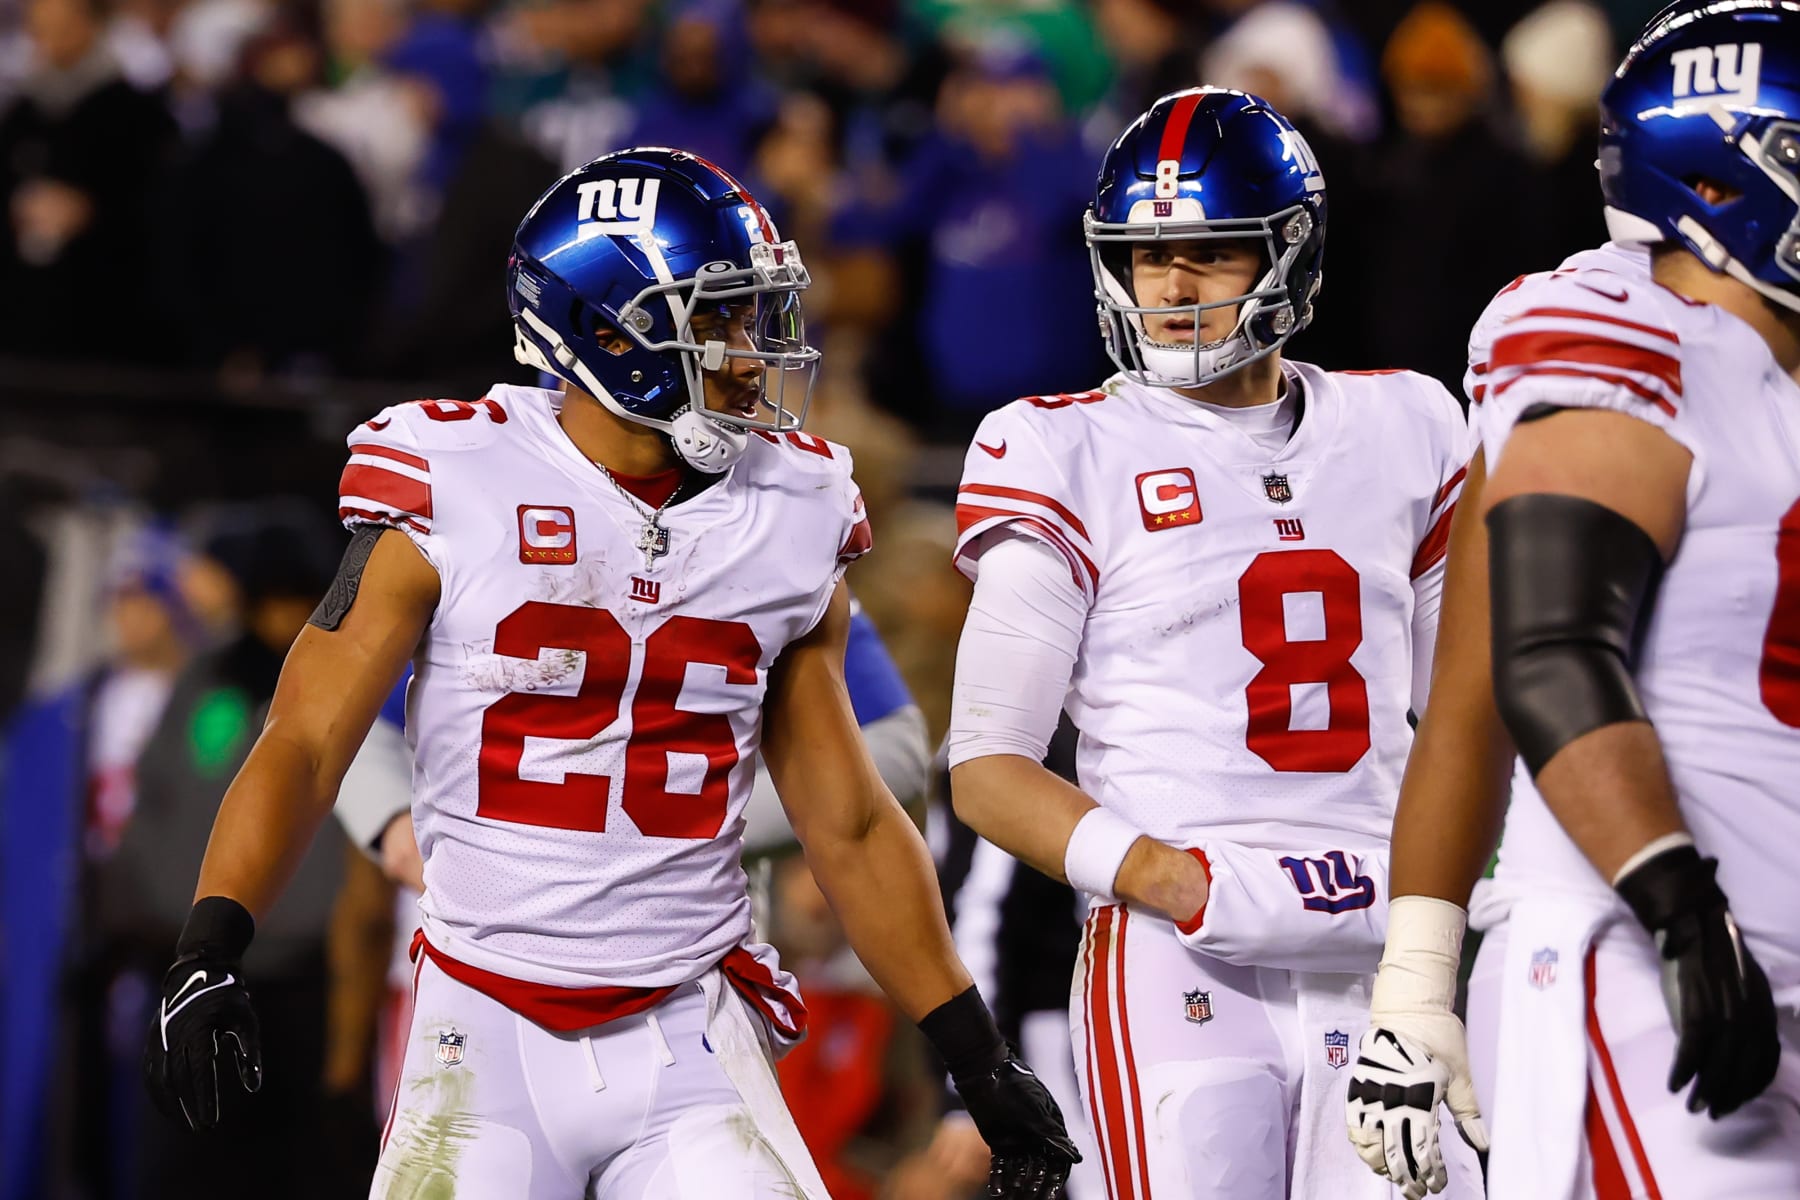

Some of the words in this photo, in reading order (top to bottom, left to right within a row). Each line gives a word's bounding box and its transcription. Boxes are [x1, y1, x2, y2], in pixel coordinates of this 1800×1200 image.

[1156, 160, 1180, 198] 8
[577, 178, 660, 239] ny
[1141, 473, 1194, 514] C
[523, 509, 571, 547] C
[1238, 549, 1371, 773] 8
[476, 600, 763, 839] 26
[1327, 1047, 1347, 1065] NFL
